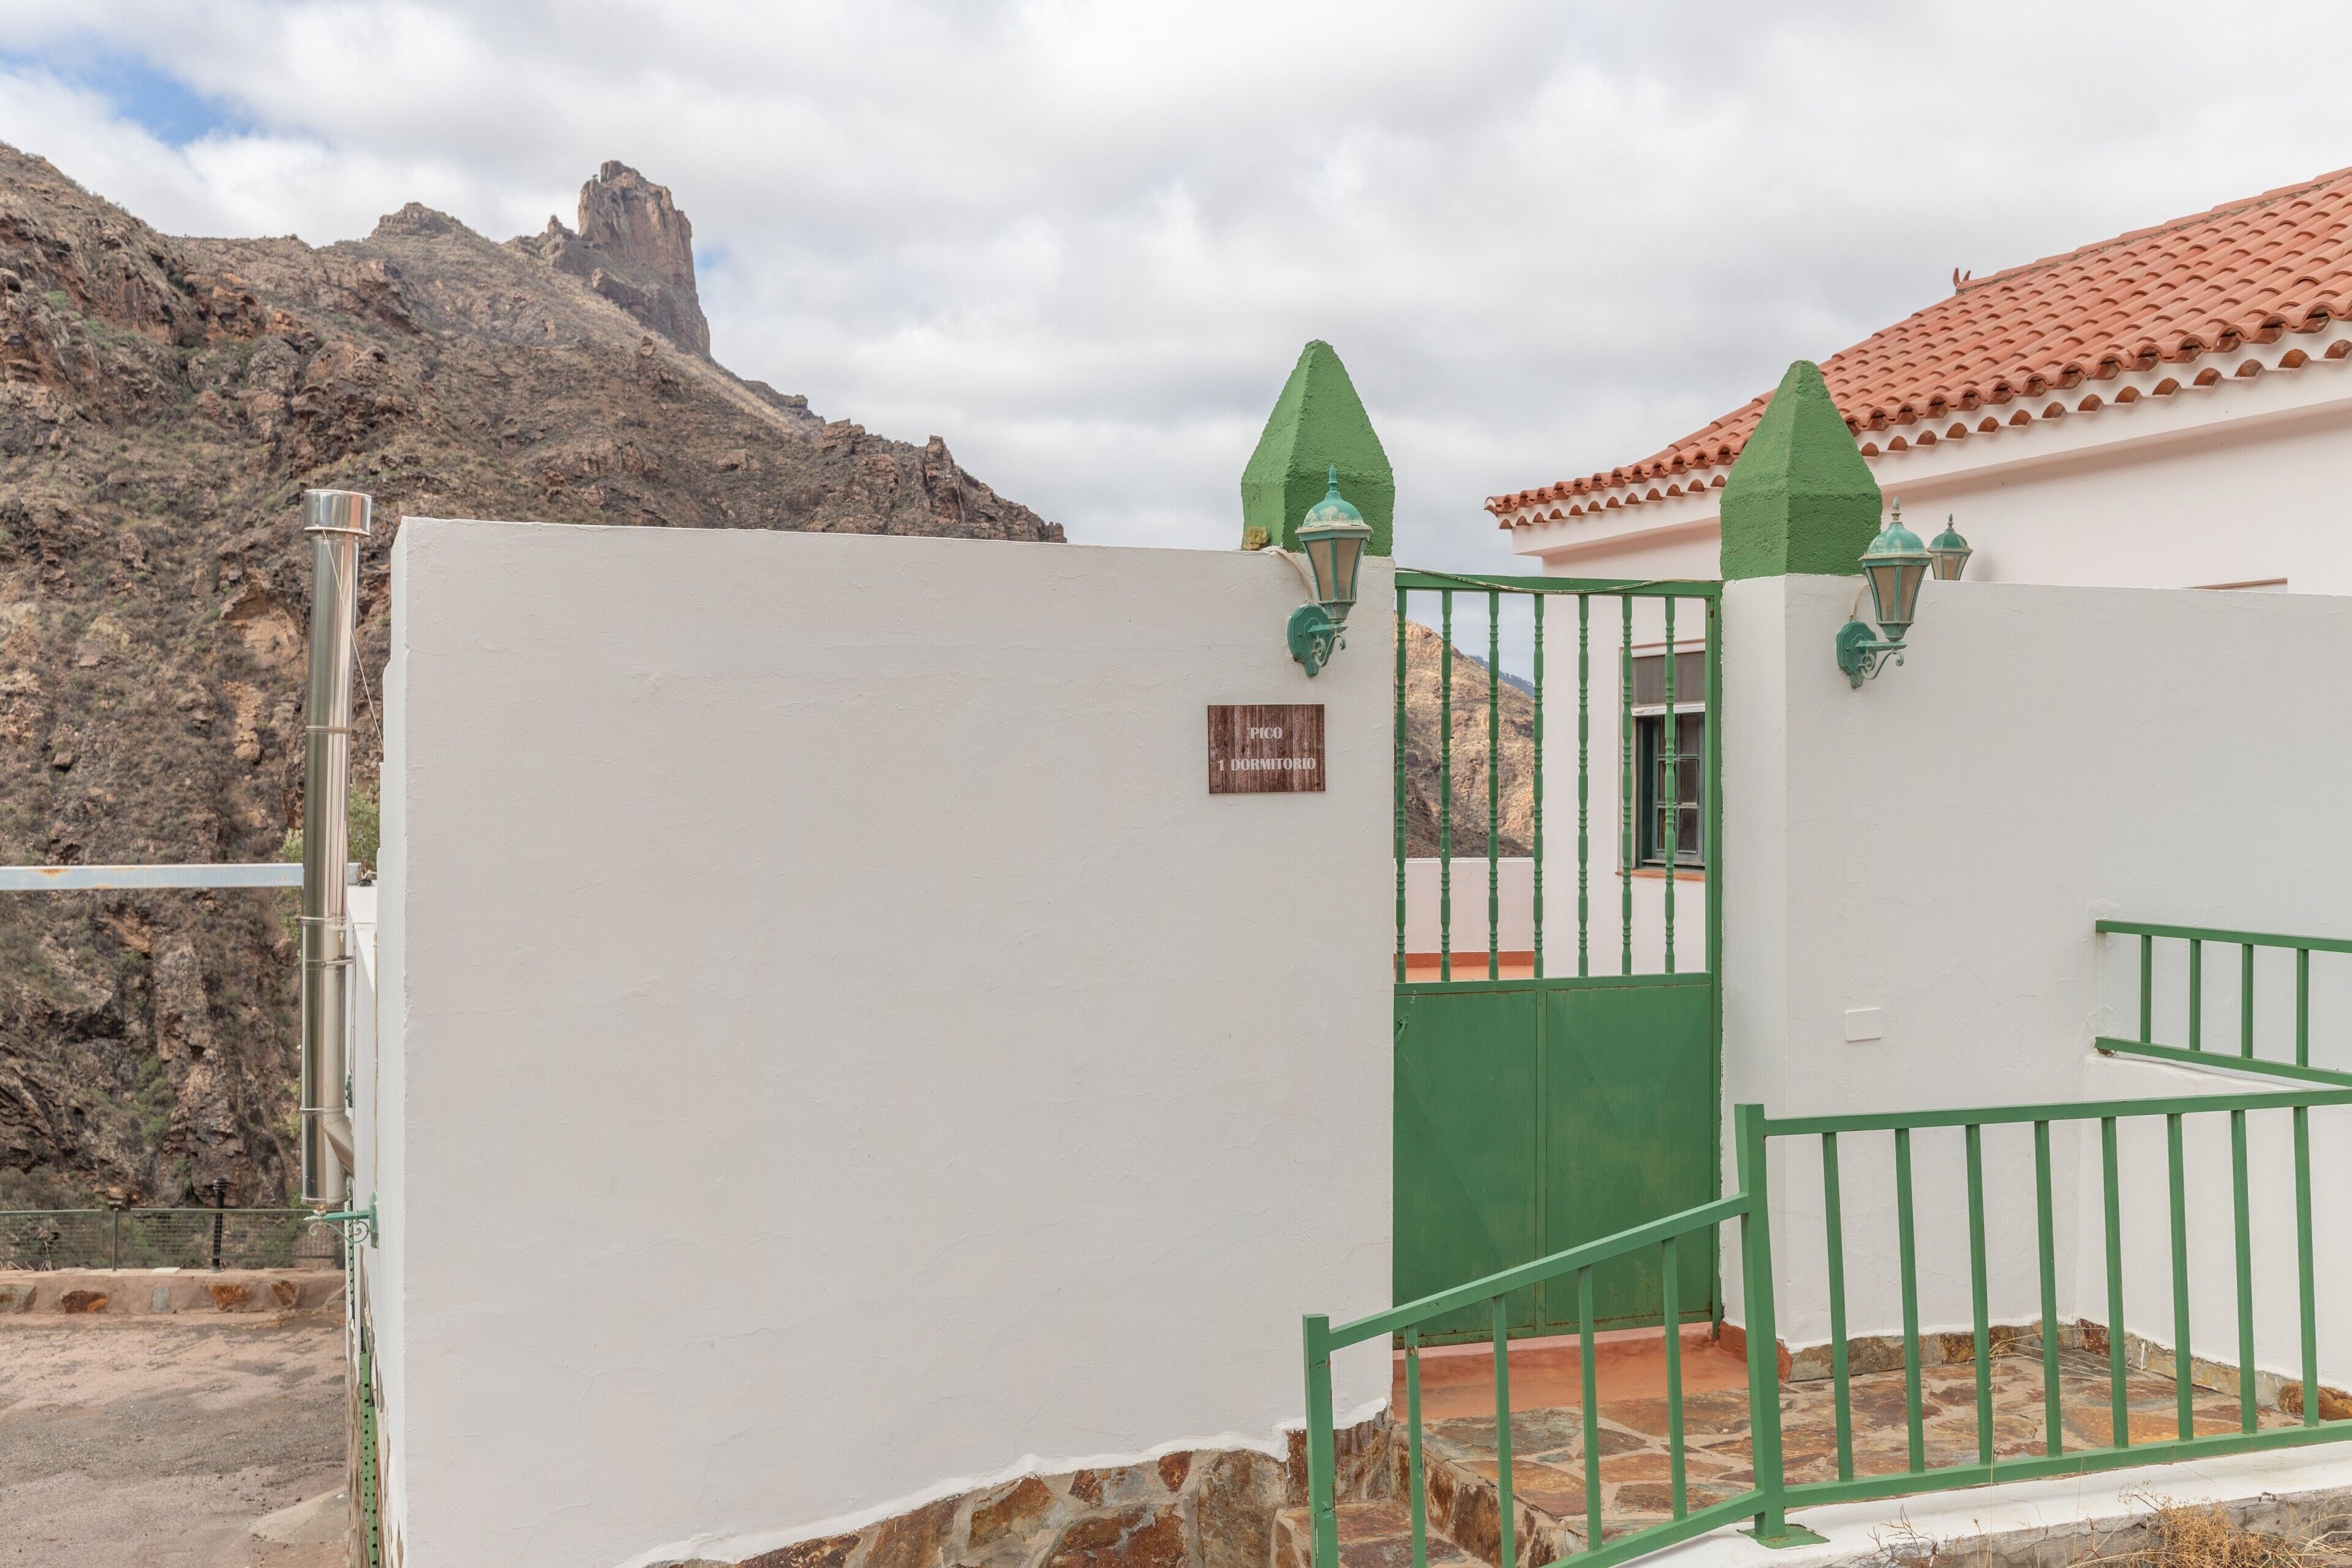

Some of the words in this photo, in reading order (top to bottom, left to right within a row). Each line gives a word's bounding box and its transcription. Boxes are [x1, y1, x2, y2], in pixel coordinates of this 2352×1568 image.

[1250, 727, 1283, 739] PICO
[1218, 759, 1224, 771] 1
[1231, 758, 1316, 771] DORMITORIO
